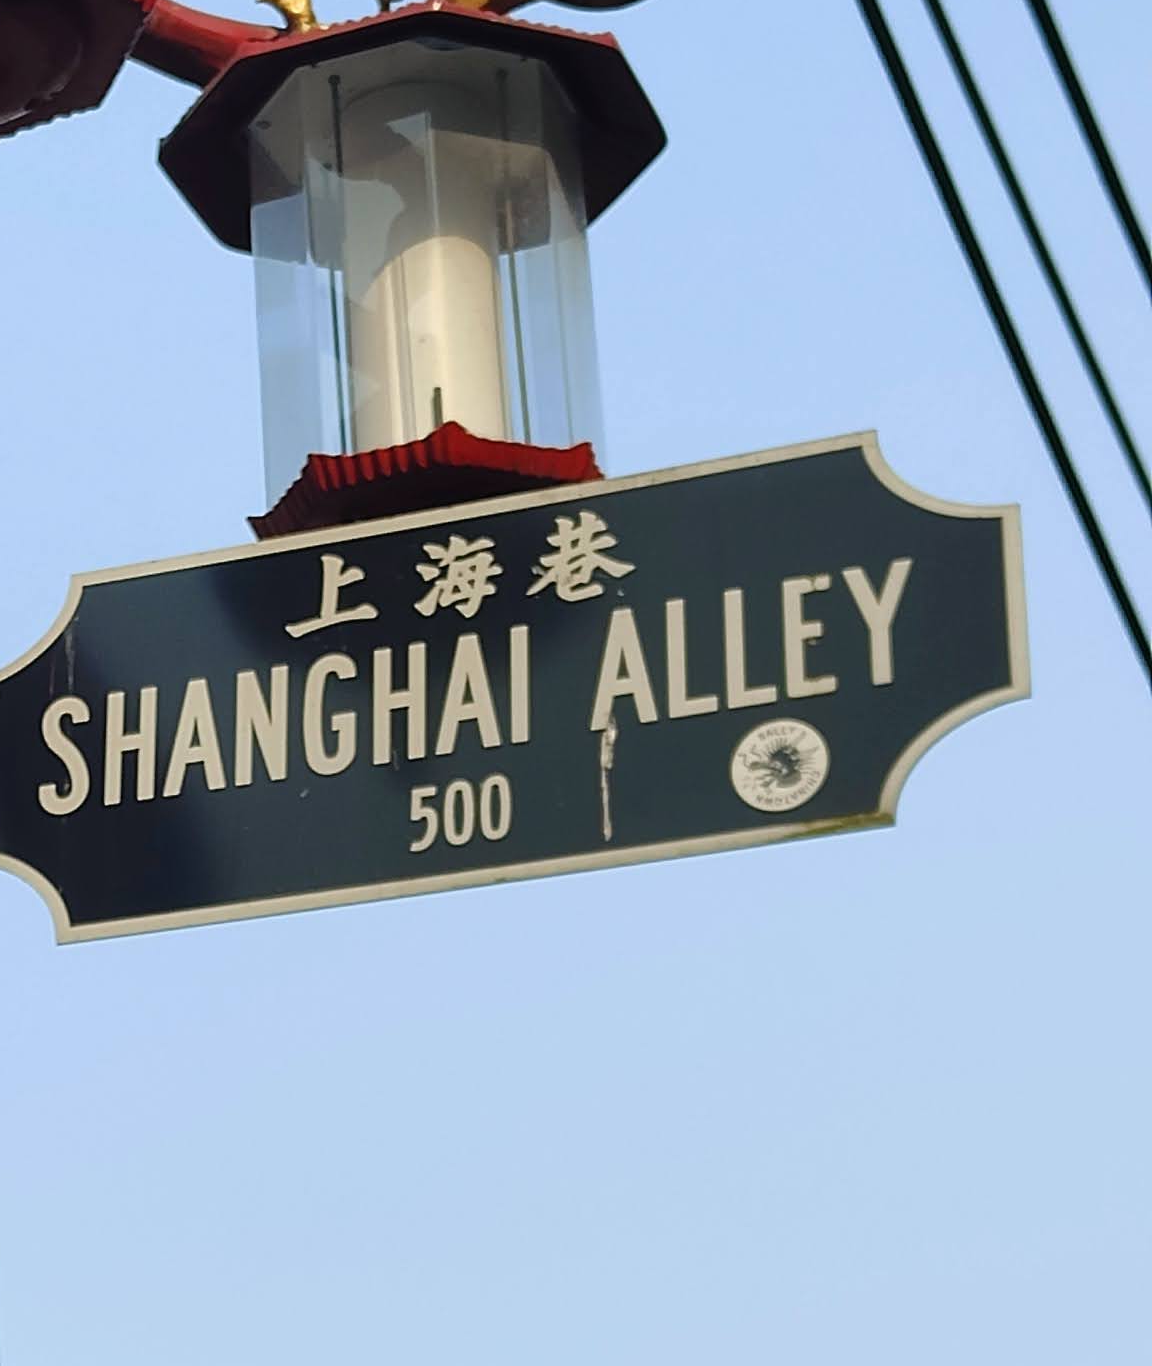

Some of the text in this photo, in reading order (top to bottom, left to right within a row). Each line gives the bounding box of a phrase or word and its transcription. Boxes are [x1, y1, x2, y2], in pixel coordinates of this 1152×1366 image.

[285, 511, 637, 639] 上海巷
[38, 556, 913, 815] SHANGHAI ALLEY
[409, 773, 512, 852] 500
